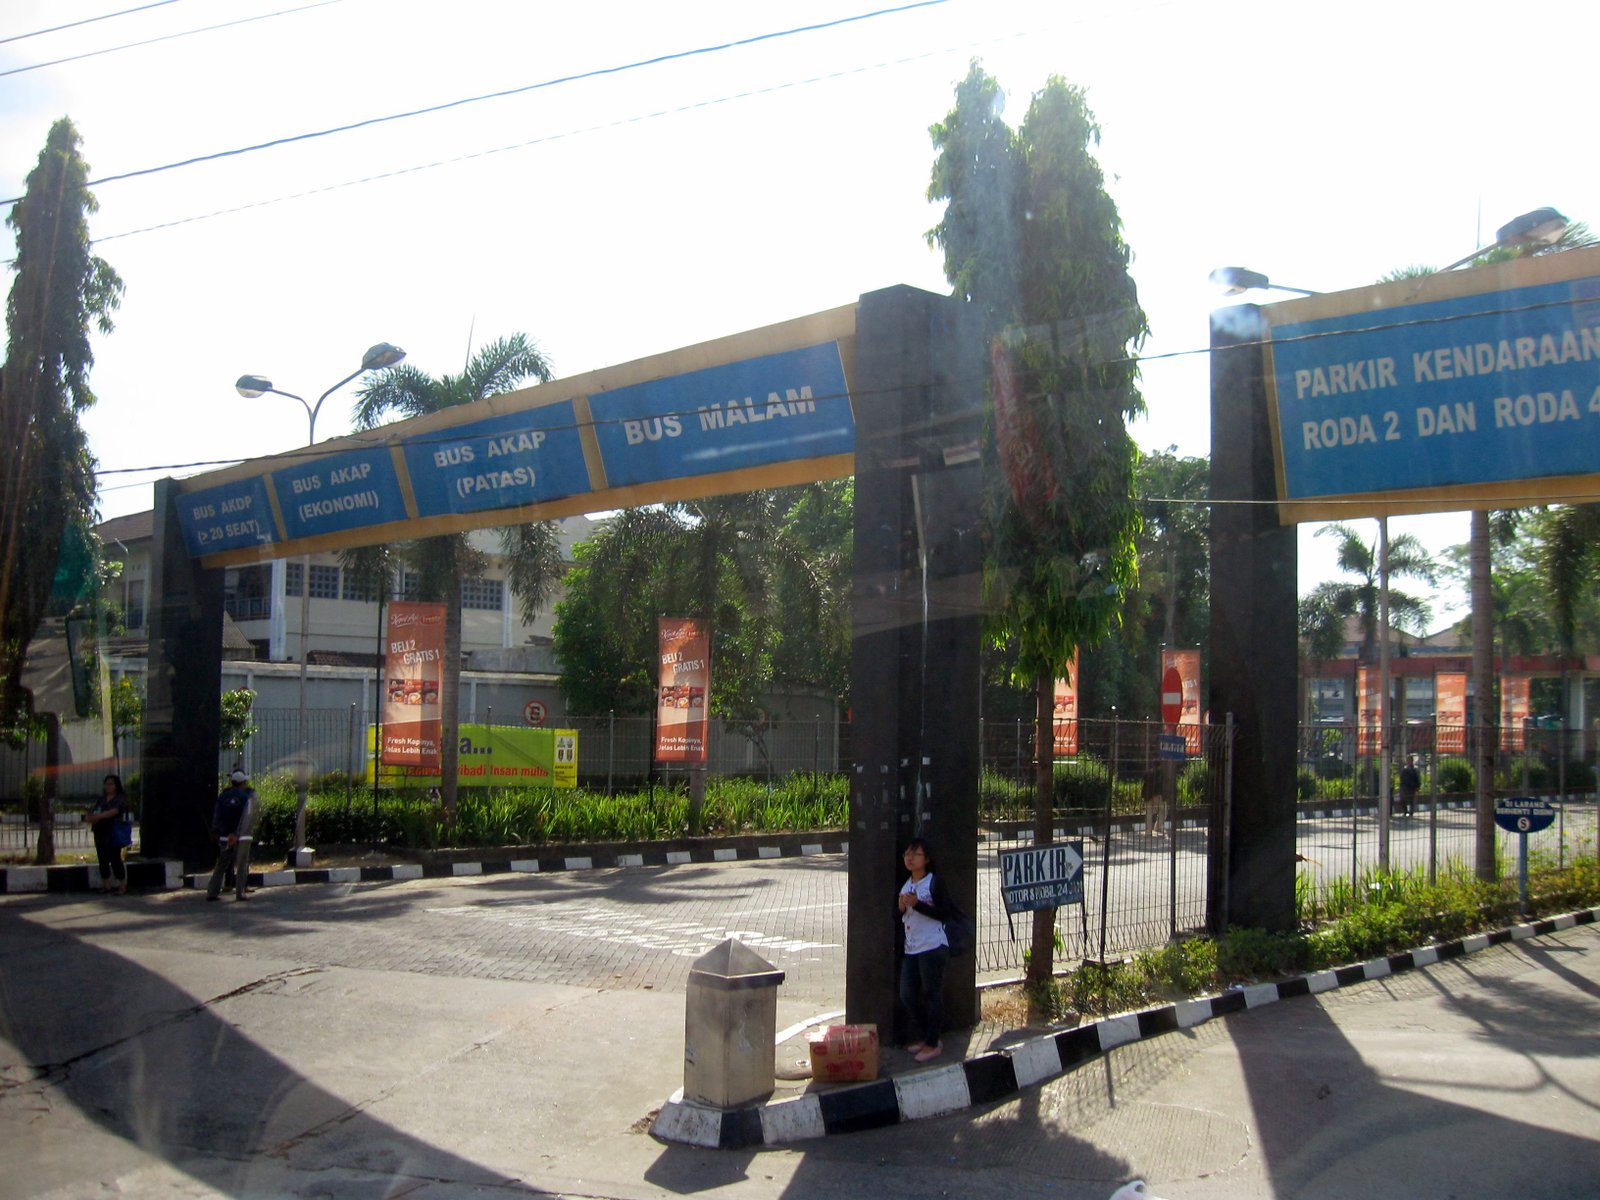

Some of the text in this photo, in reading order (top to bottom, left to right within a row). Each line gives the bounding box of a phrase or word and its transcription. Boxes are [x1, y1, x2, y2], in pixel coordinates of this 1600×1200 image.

[1295, 326, 1600, 400] PARKIR KENDARAAN
[623, 385, 816, 446] BUS MALAM
[1302, 384, 1600, 450] RODA 2 DAN RODA 4
[432, 431, 546, 468] BUS AKAP
[292, 463, 371, 494] BUS AKAP
[456, 466, 536, 498] (PATAS)
[192, 495, 252, 520] BUS AKDP
[299, 490, 380, 523] (EKONOMI)
[209, 527, 224, 540] 20
[225, 519, 260, 538] SEAT)
[391, 639, 416, 654] BELI 2
[403, 648, 440, 665] GRATIS 1
[677, 651, 683, 662] 2
[672, 659, 705, 673] GRATIS 1
[387, 736, 407, 745] Fresh
[458, 764, 486, 777] ribadi
[1519, 818, 1528, 829] S
[1002, 848, 1066, 887] PARKIR
[1006, 888, 1029, 904] OTOR
[1057, 882, 1068, 897] 24
